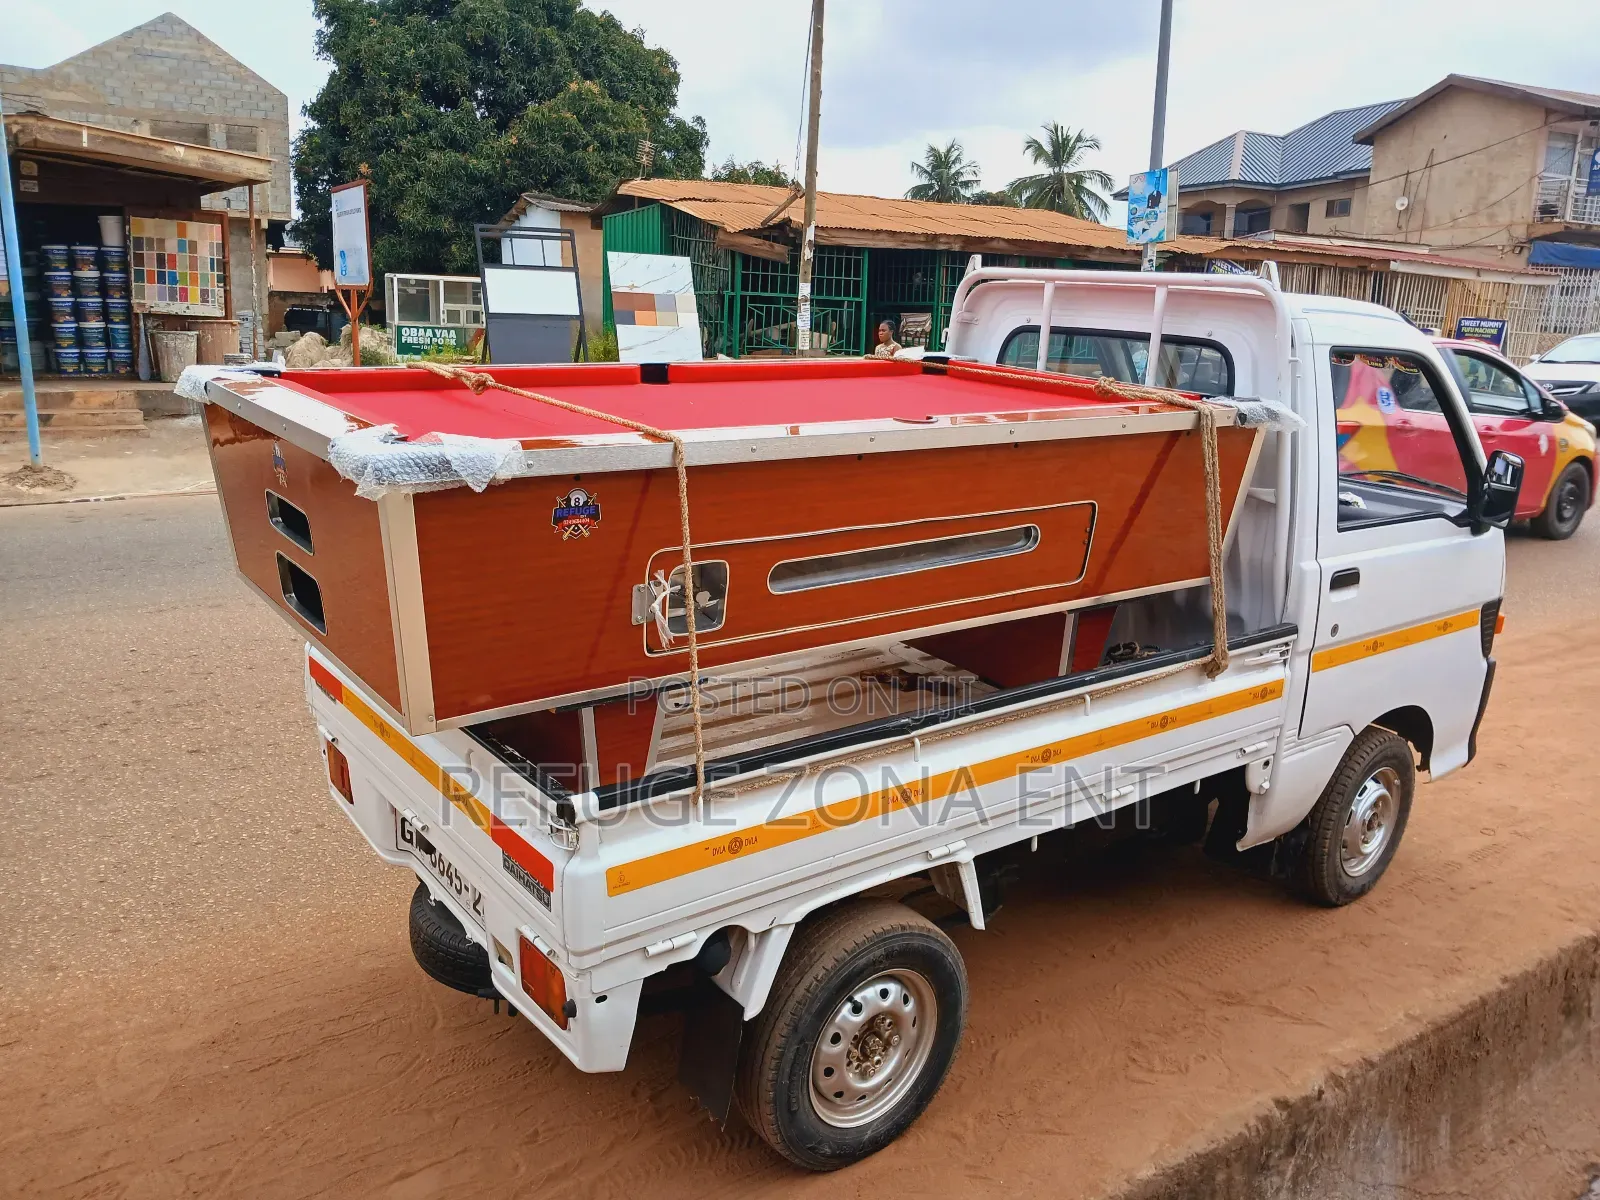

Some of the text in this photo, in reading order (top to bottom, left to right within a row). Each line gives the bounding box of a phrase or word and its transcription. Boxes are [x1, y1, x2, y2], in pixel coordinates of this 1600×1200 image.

[1461, 319, 1503, 329] SWEET MUMMY
[401, 327, 457, 339] OBAA YAA
[1474, 327, 1499, 335] MACHINE
[401, 336, 431, 344] FRESH
[573, 496, 581, 506] 8
[556, 506, 596, 518] REFUGE
[712, 845, 726, 857] DVLA
[744, 835, 758, 847] DVLA
[503, 856, 550, 909] DAIHATSU
